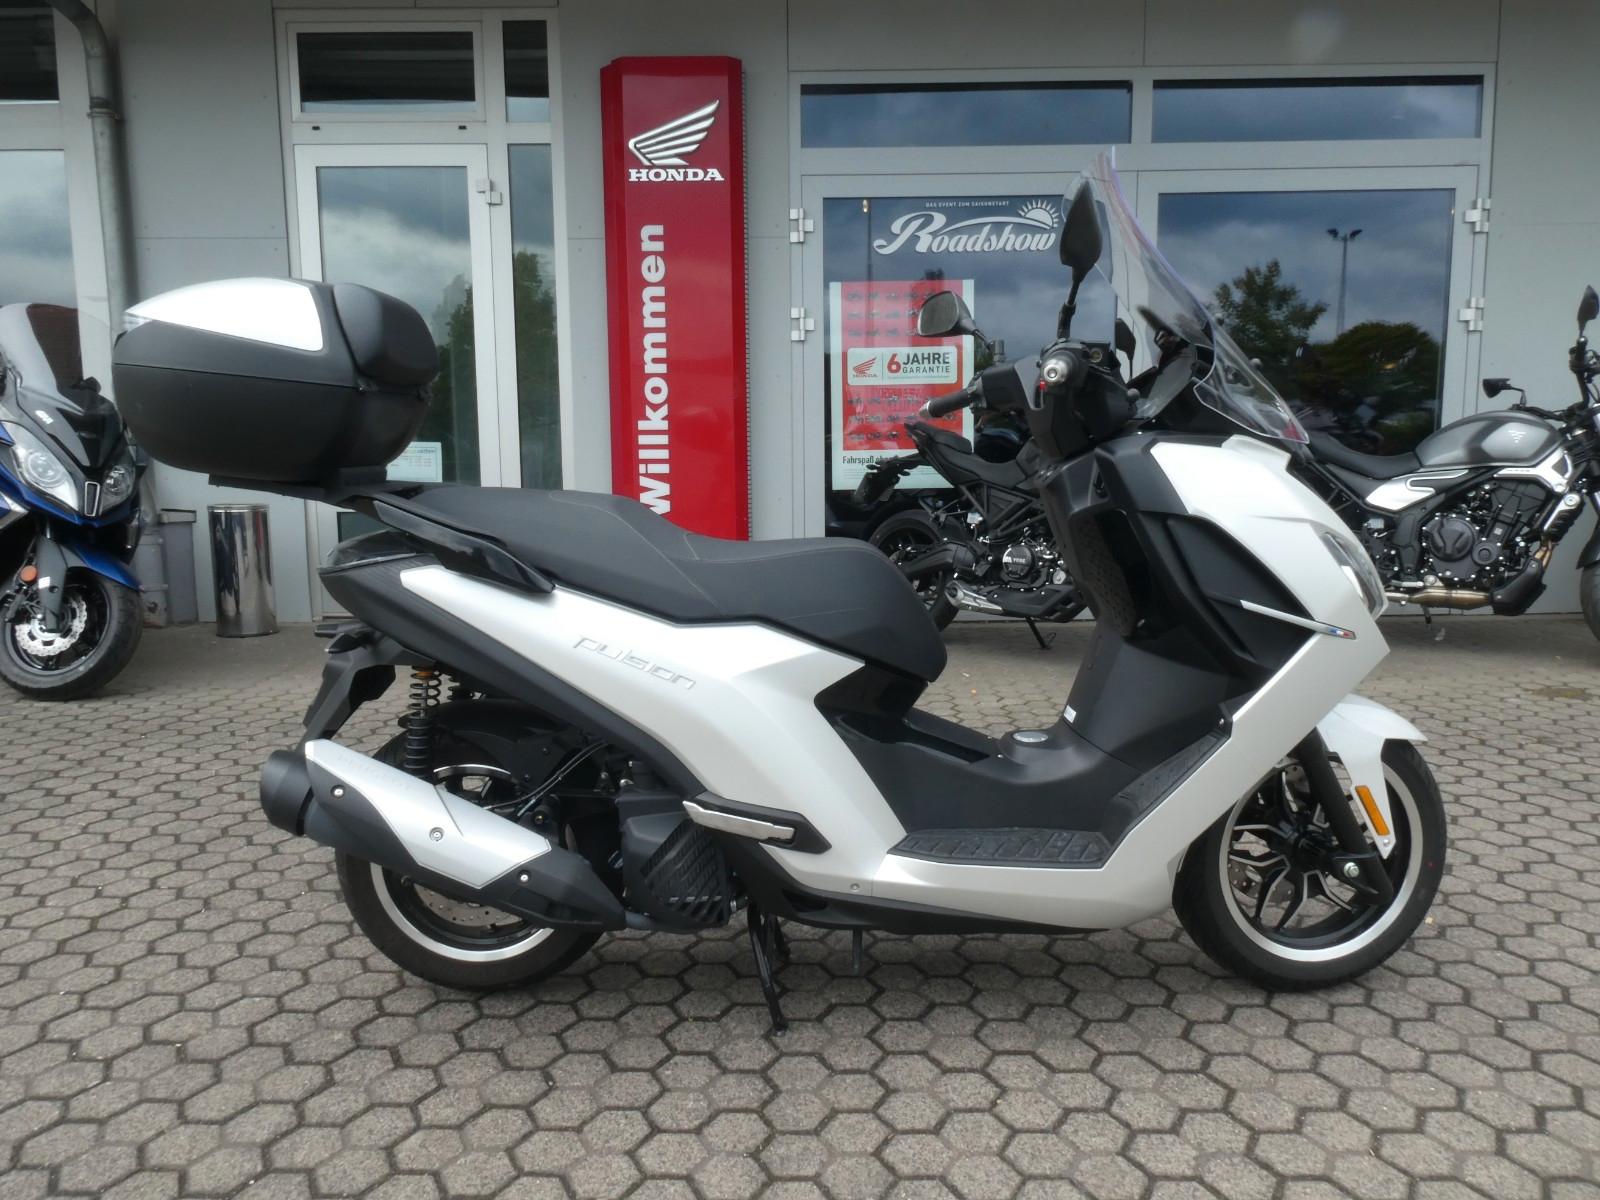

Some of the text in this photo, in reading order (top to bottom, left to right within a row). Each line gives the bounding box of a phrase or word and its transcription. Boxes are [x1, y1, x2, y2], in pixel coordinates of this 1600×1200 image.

[628, 168, 725, 182] HONDA
[873, 211, 1056, 255] Roadshow
[637, 224, 671, 515] Willkommen
[887, 352, 950, 374] 6 JAHRE
[902, 365, 950, 374] GARANTIE
[842, 455, 875, 466] Fahrspaß
[573, 636, 696, 690] pulsion
